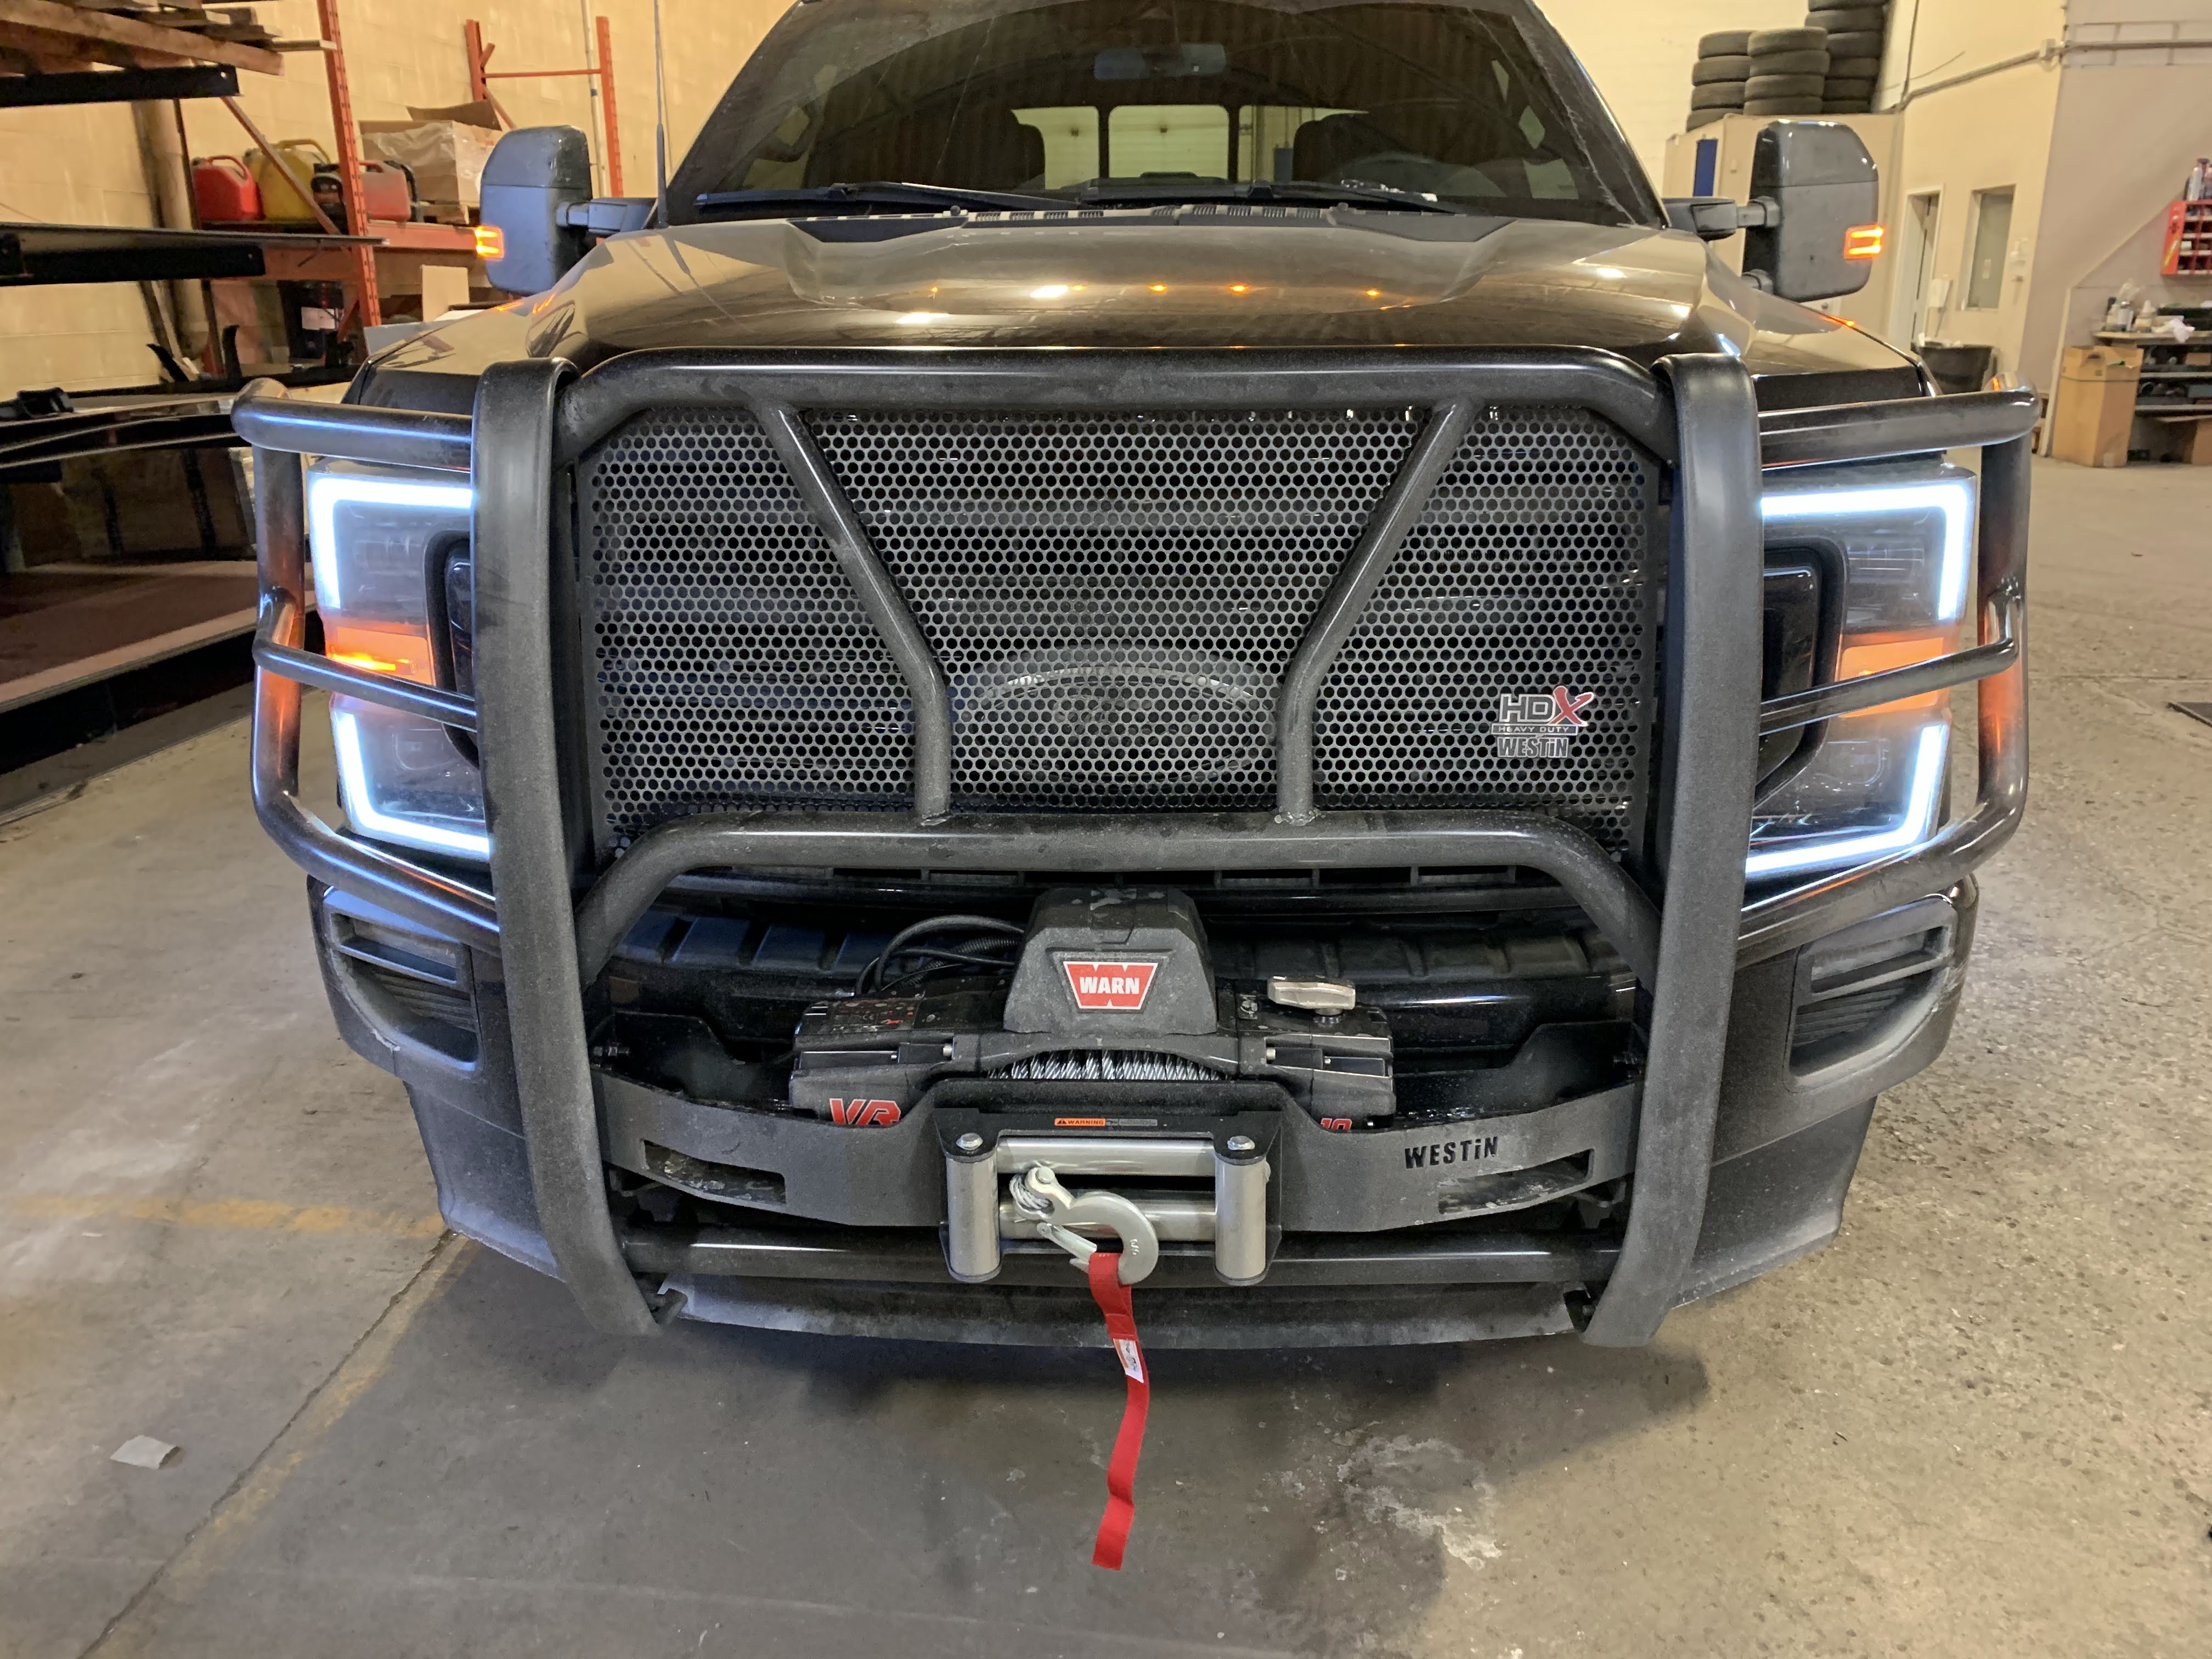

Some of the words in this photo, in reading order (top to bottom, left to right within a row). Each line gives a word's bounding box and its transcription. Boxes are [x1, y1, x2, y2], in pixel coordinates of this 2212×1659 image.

[1499, 686, 1595, 727] HDX
[1079, 977, 1140, 995] WARN
[829, 1098, 901, 1126] VR
